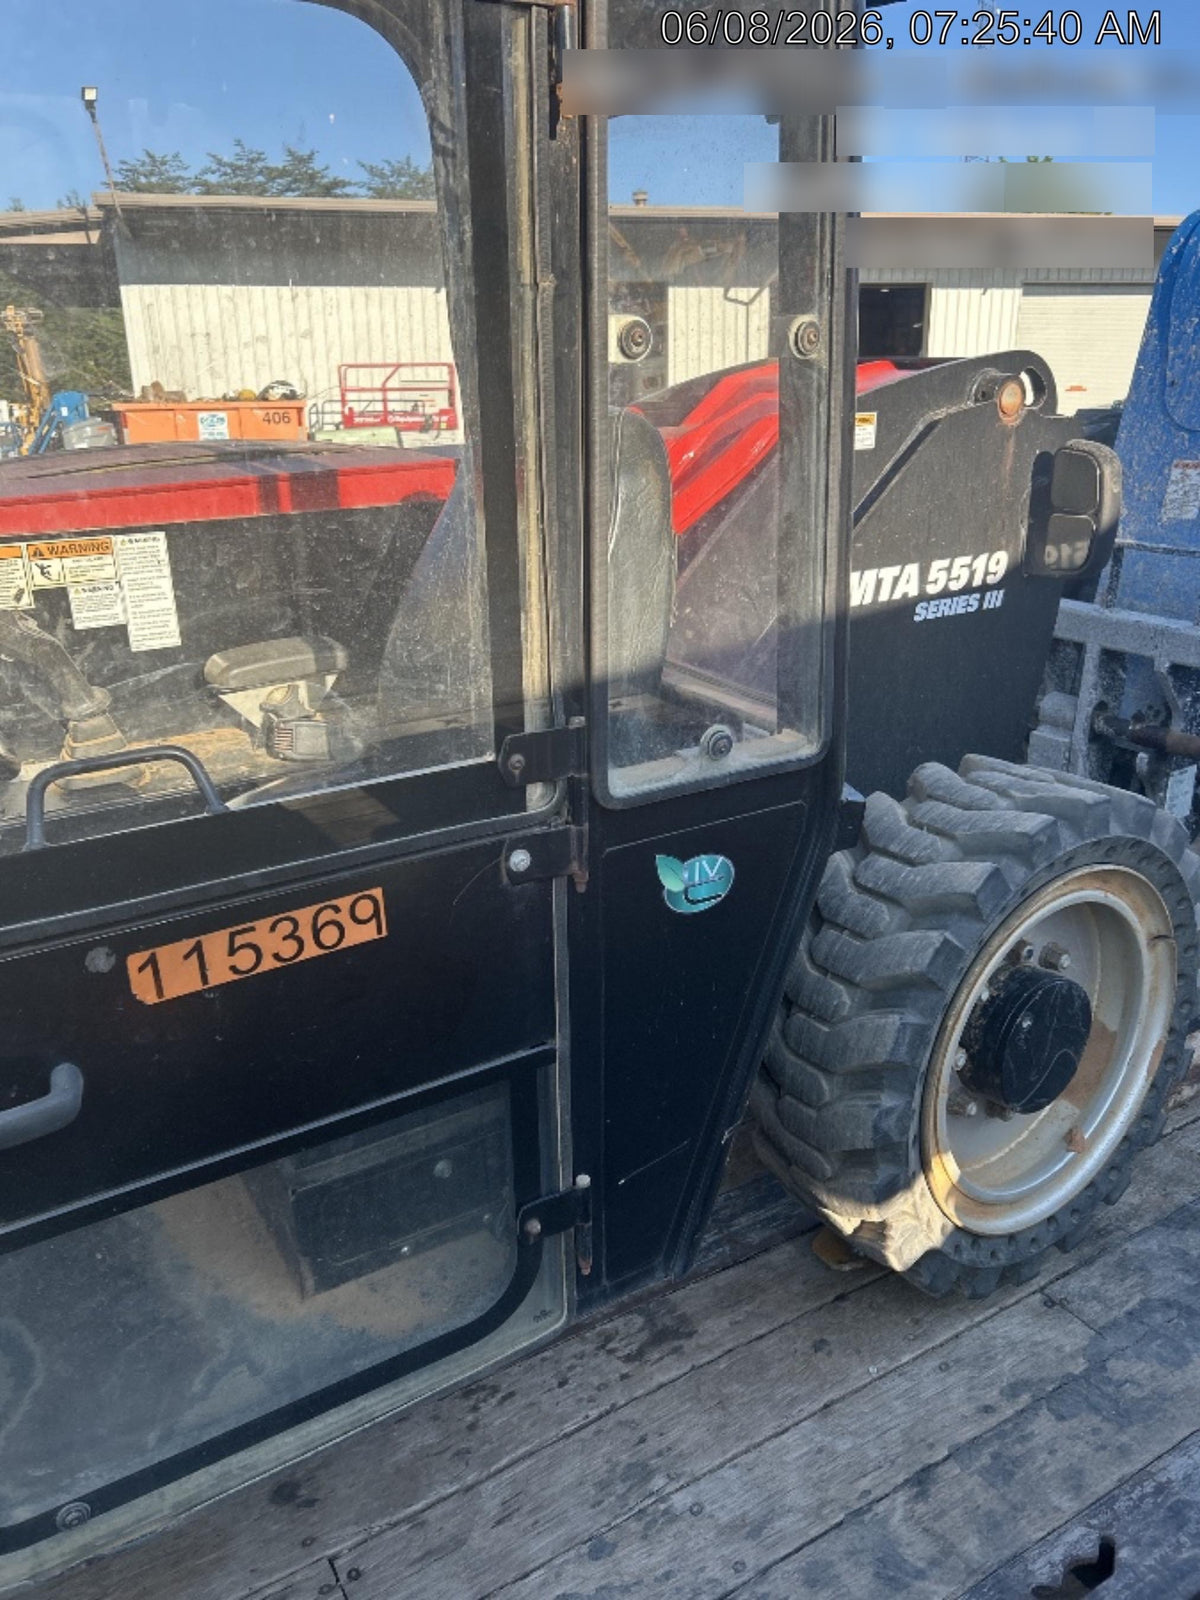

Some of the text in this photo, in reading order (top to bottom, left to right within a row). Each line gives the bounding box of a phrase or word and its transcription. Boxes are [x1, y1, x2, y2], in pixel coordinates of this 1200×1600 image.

[263, 411, 291, 425] 406
[48, 541, 109, 556] WARNING
[850, 550, 1009, 607] MTA 5519
[914, 589, 1005, 622] SERIES III
[137, 892, 384, 1000] 115369
